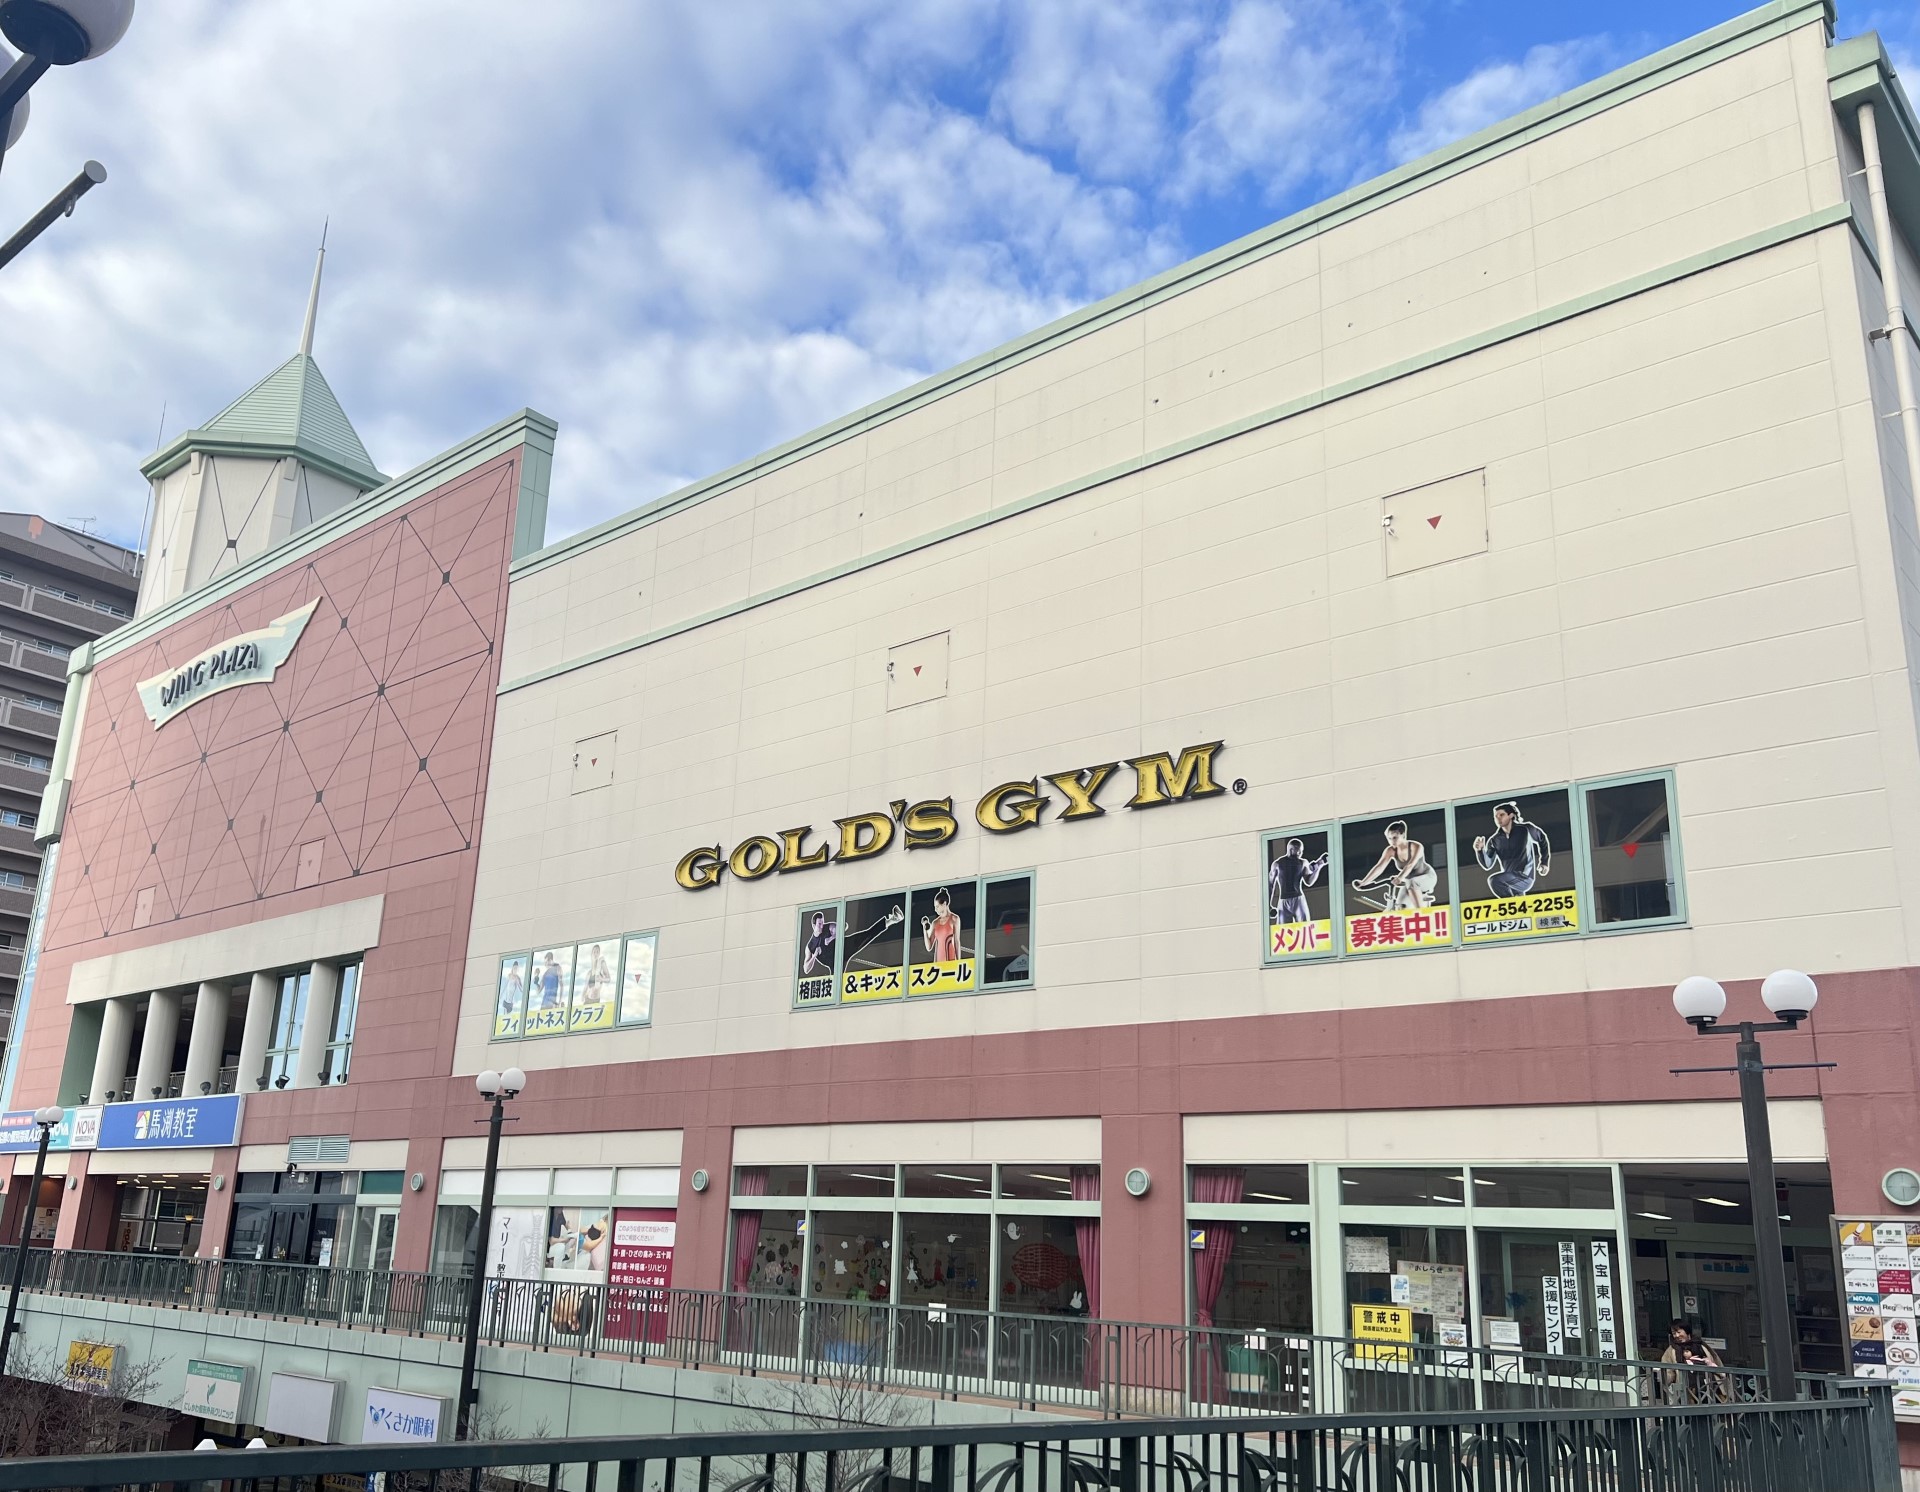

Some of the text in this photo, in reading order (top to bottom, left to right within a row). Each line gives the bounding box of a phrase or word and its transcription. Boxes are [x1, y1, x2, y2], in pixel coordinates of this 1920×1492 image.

[160, 642, 261, 707] WING PLAZA
[674, 796, 958, 891] GOLD'S
[975, 739, 1228, 834] GYM
[1463, 894, 1576, 922] 077-554-2255
[1272, 910, 1448, 955] メンバー 募集中!!
[1466, 916, 1562, 937] ゴールドジム 検索
[799, 978, 833, 1001] 格闘技
[910, 962, 973, 988] スクール
[75, 1119, 97, 1135] NOVA
[1414, 1264, 1444, 1274] おしらせ
[1560, 1242, 1579, 1338] 栗東市地域子育て
[1592, 1242, 1615, 1359] 大宝東児童館
[1852, 1295, 1875, 1303] NOVA
[1363, 1309, 1401, 1326] 警戒中
[1543, 1276, 1560, 1355] 支援センター
[1853, 1305, 1875, 1313] NOVA
[1362, 1325, 1403, 1334] 関係者以外立入禁止
[384, 1411, 435, 1439] くさか眼科
